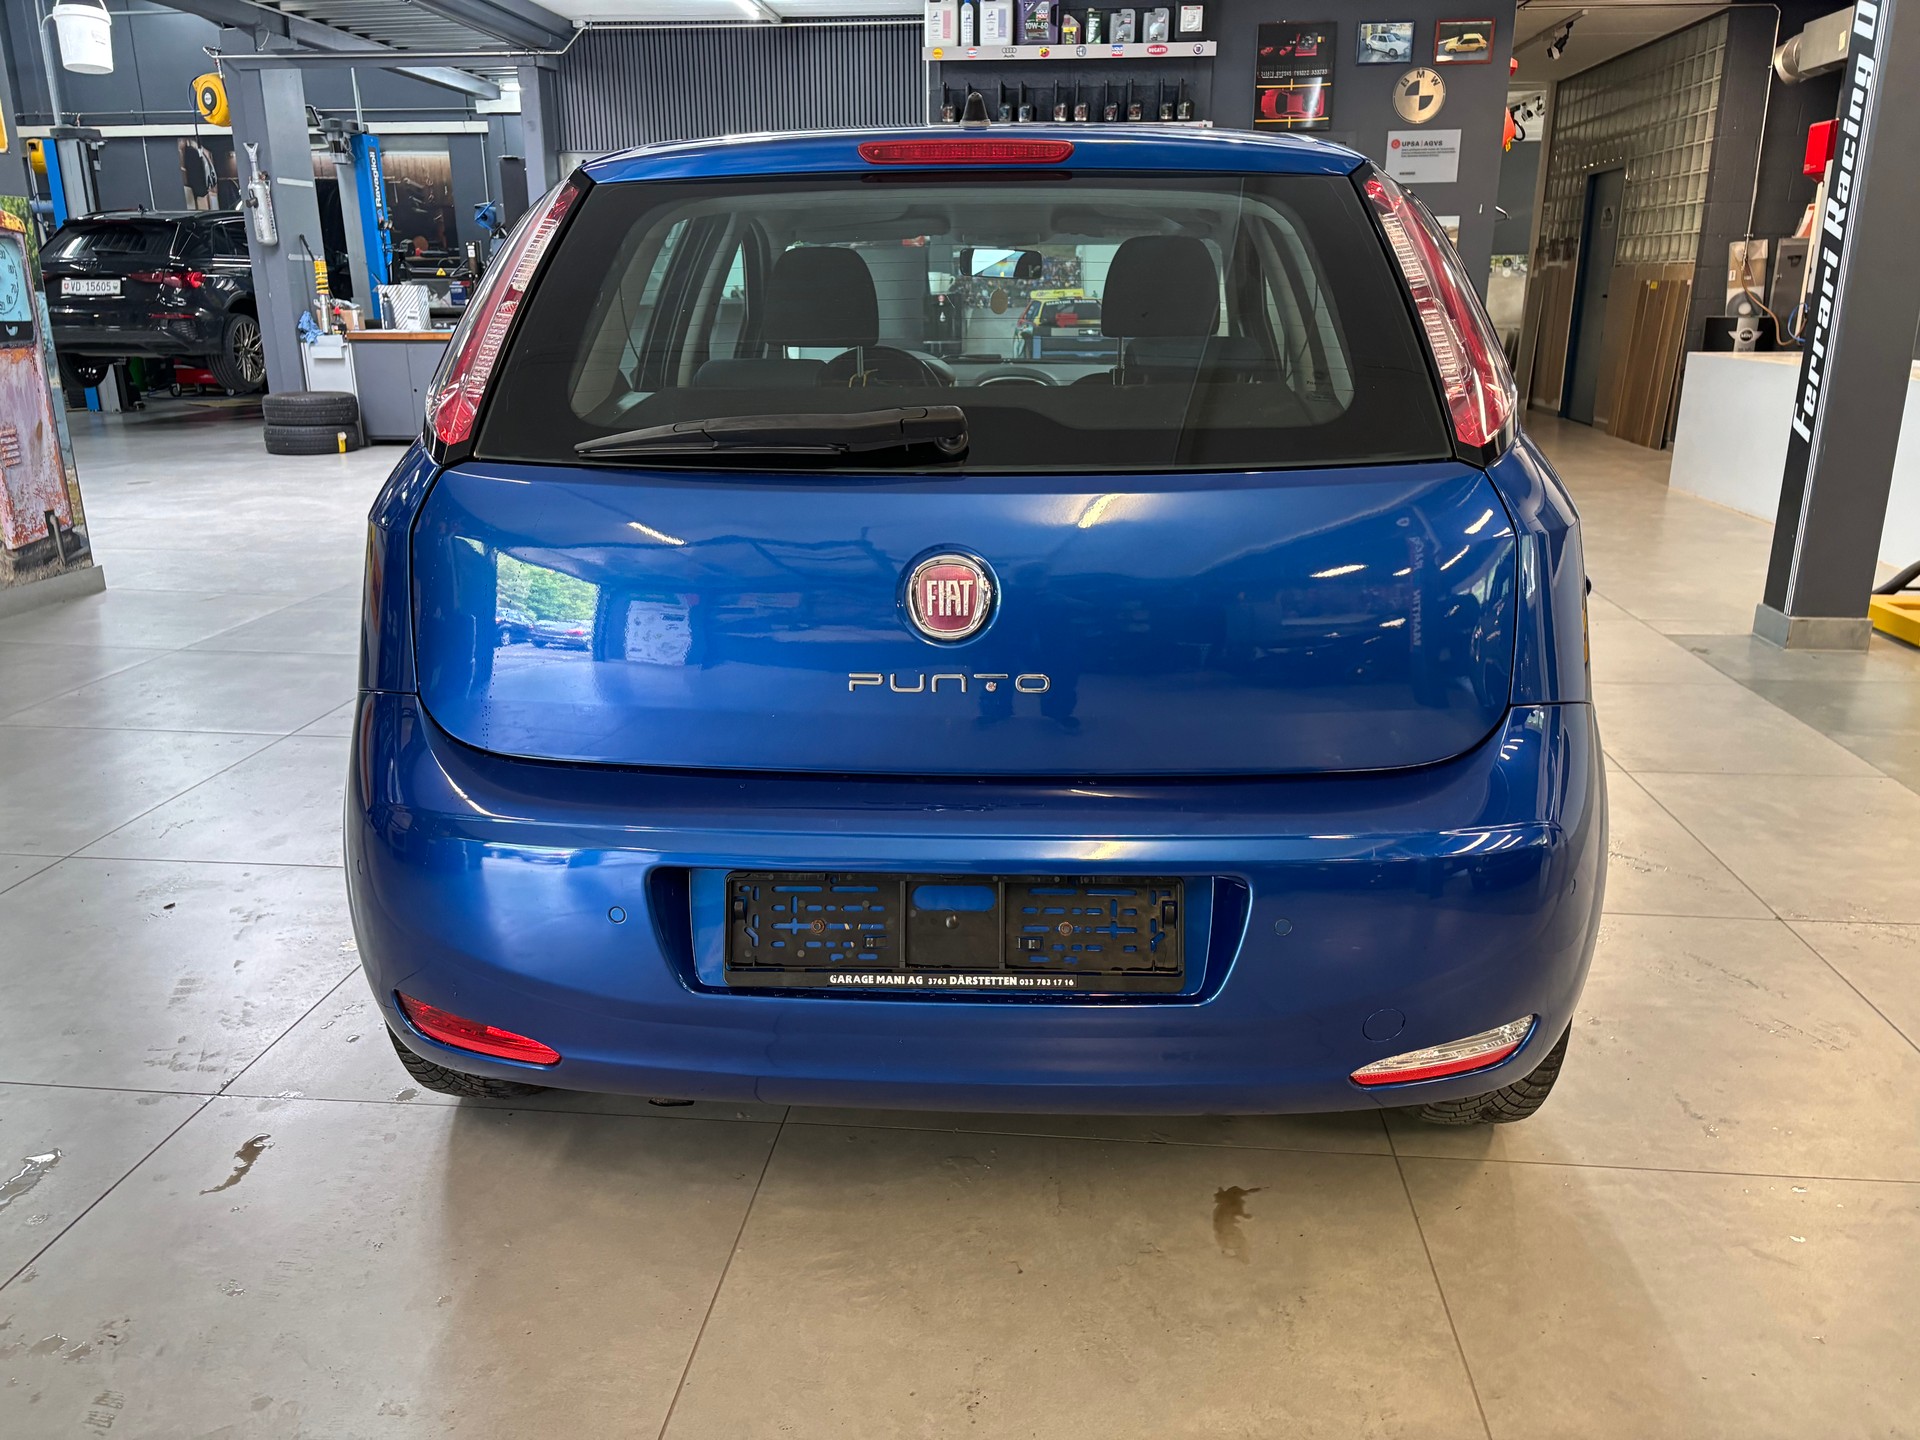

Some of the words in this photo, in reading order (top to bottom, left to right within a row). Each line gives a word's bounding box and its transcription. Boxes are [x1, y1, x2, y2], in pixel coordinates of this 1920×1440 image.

[1025, 22, 1049, 30] 10W-60
[1400, 70, 1441, 88] BMW
[368, 151, 382, 208] Ravaglioli
[1793, 247, 1838, 443] Ferrari
[1823, 53, 1875, 241] Racing
[926, 579, 974, 617] FIAT
[848, 672, 1051, 694] PUNTO
[829, 974, 874, 984] GARAGE
[876, 975, 905, 985] MANI
[907, 975, 923, 985] AG
[927, 977, 947, 985] 3763
[949, 974, 1018, 986] DÄRSTETTEN
[1019, 978, 1034, 986] 033
[1053, 978, 1063, 986] 17
[1064, 978, 1075, 986] 16
